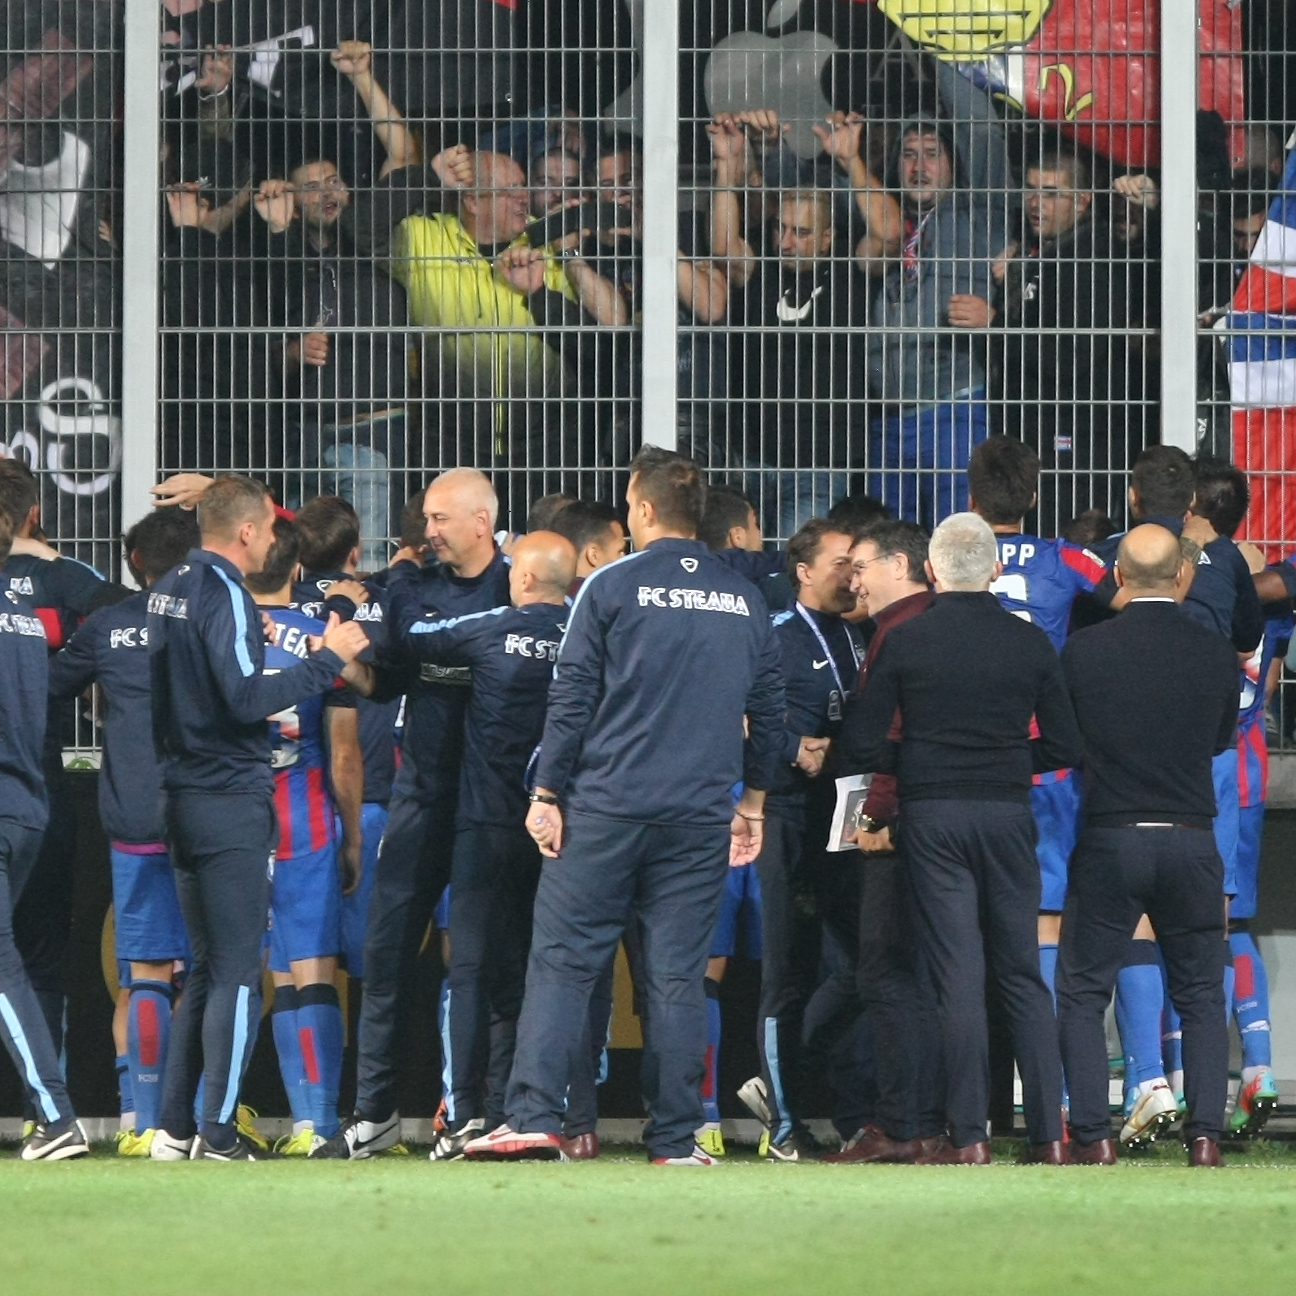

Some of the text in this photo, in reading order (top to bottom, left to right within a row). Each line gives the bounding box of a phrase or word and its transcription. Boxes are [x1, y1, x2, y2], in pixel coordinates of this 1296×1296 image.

[637, 587, 750, 616] FC STEAUA
[110, 627, 137, 649] FC
[505, 634, 533, 658] FC
